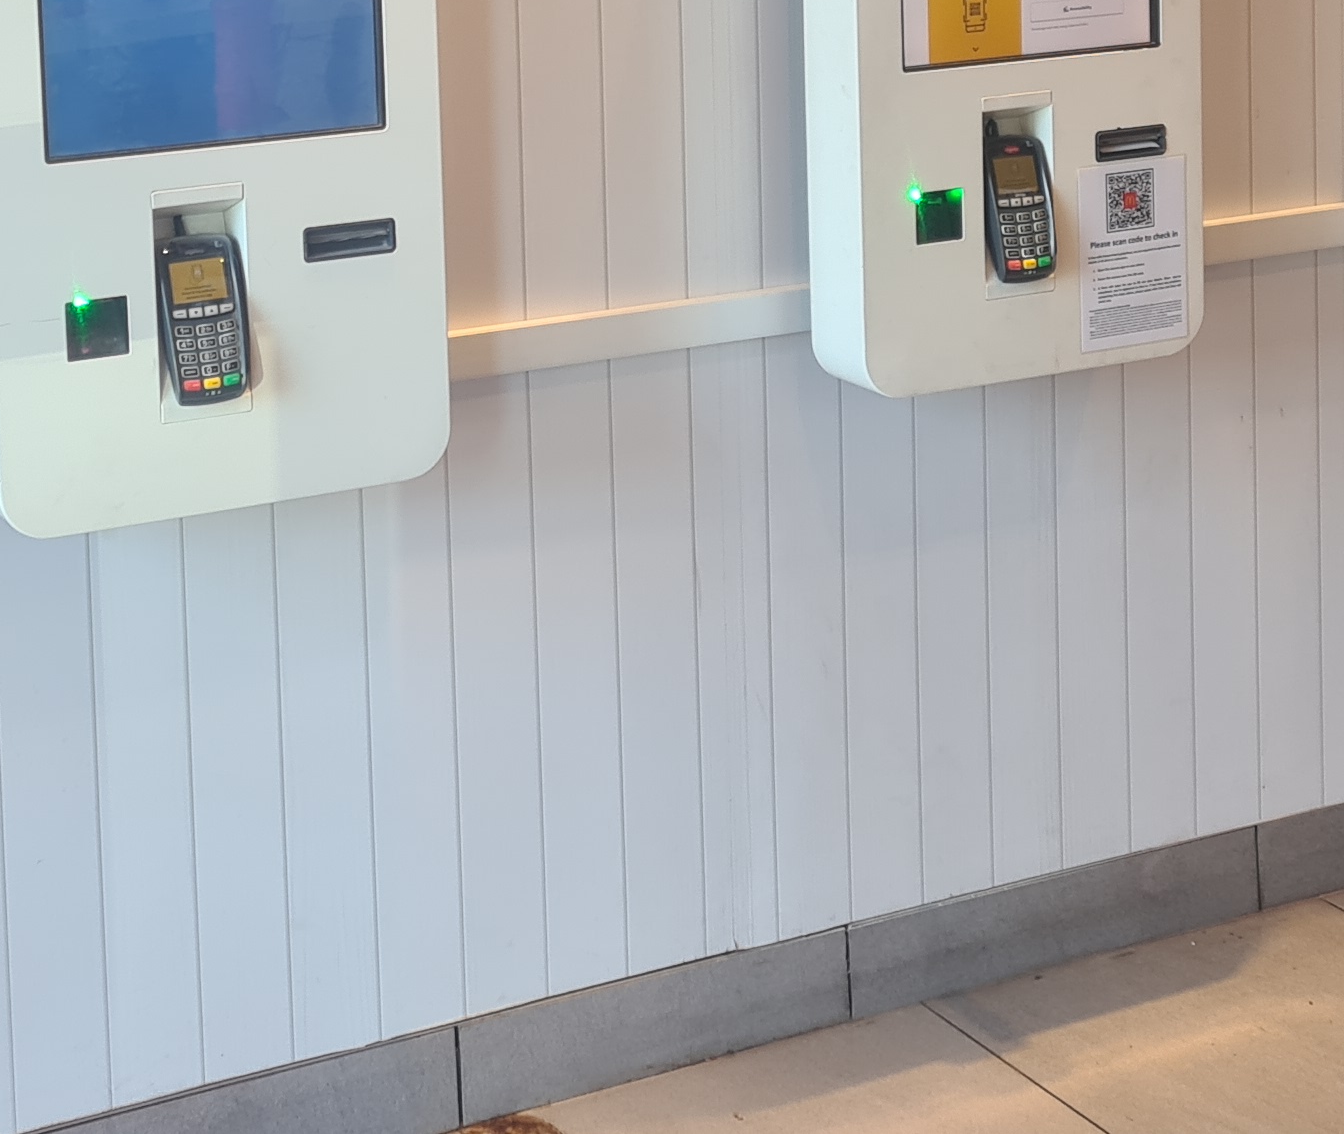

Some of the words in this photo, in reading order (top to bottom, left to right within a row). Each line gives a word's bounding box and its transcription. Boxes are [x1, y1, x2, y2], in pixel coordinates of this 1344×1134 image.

[1090, 241, 1111, 249] Please
[1128, 236, 1144, 244] code
[1144, 234, 1152, 242] to
[1153, 231, 1170, 240] check
